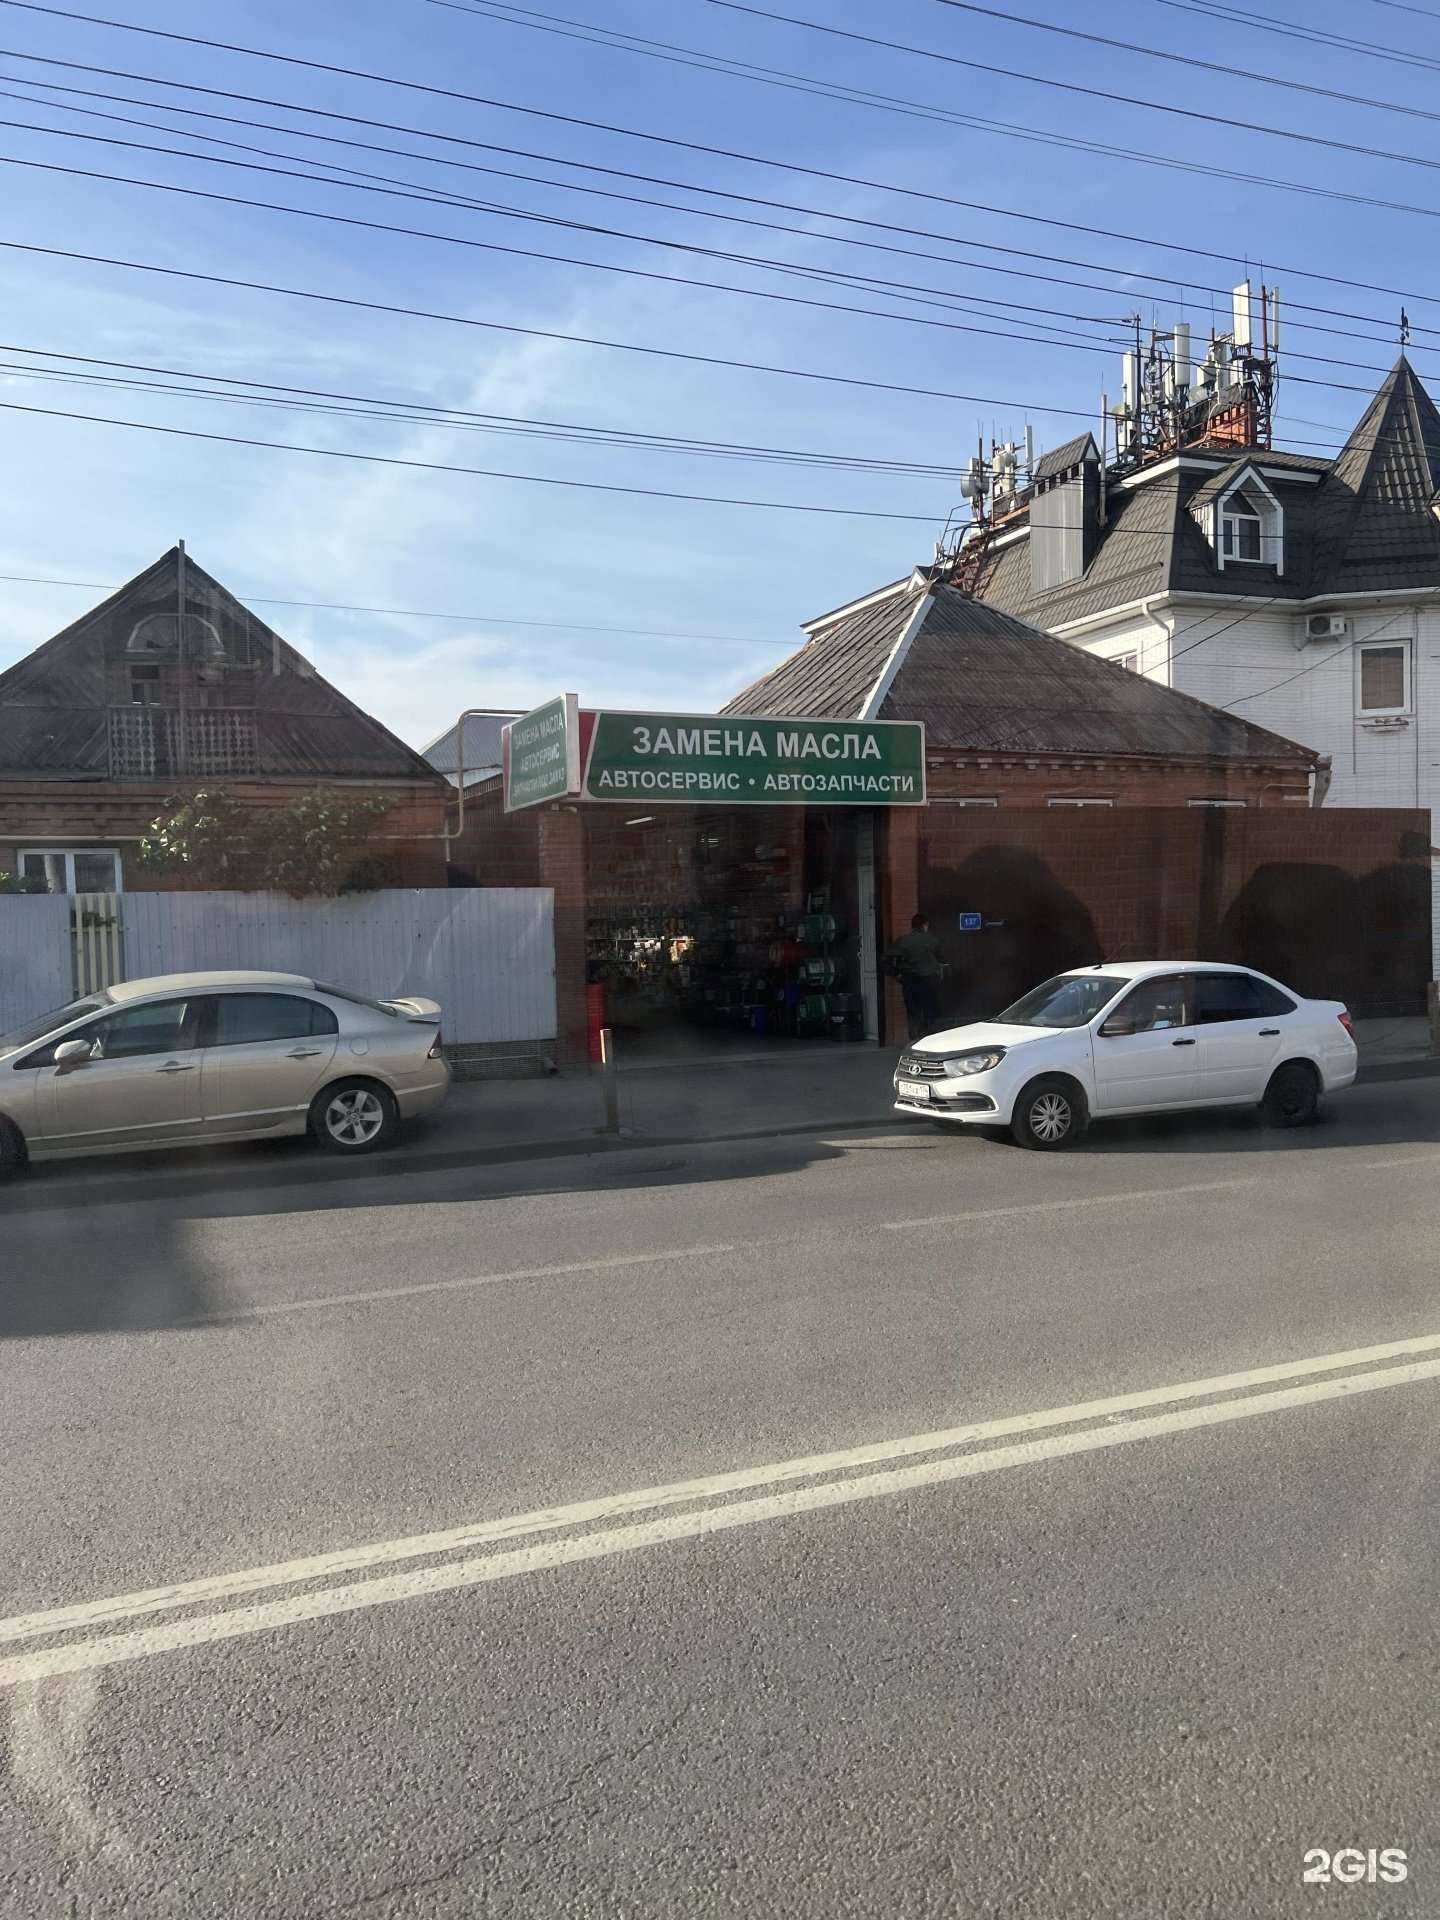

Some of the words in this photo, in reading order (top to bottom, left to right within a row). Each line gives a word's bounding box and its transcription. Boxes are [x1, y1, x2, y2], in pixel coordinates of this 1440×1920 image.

[632, 726, 767, 758] ЗАМЕНА
[776, 731, 882, 760] МАСЛА
[598, 769, 740, 791] АВТОСЕРВИС
[763, 773, 914, 793] АВТОЗАПЧАСТИ
